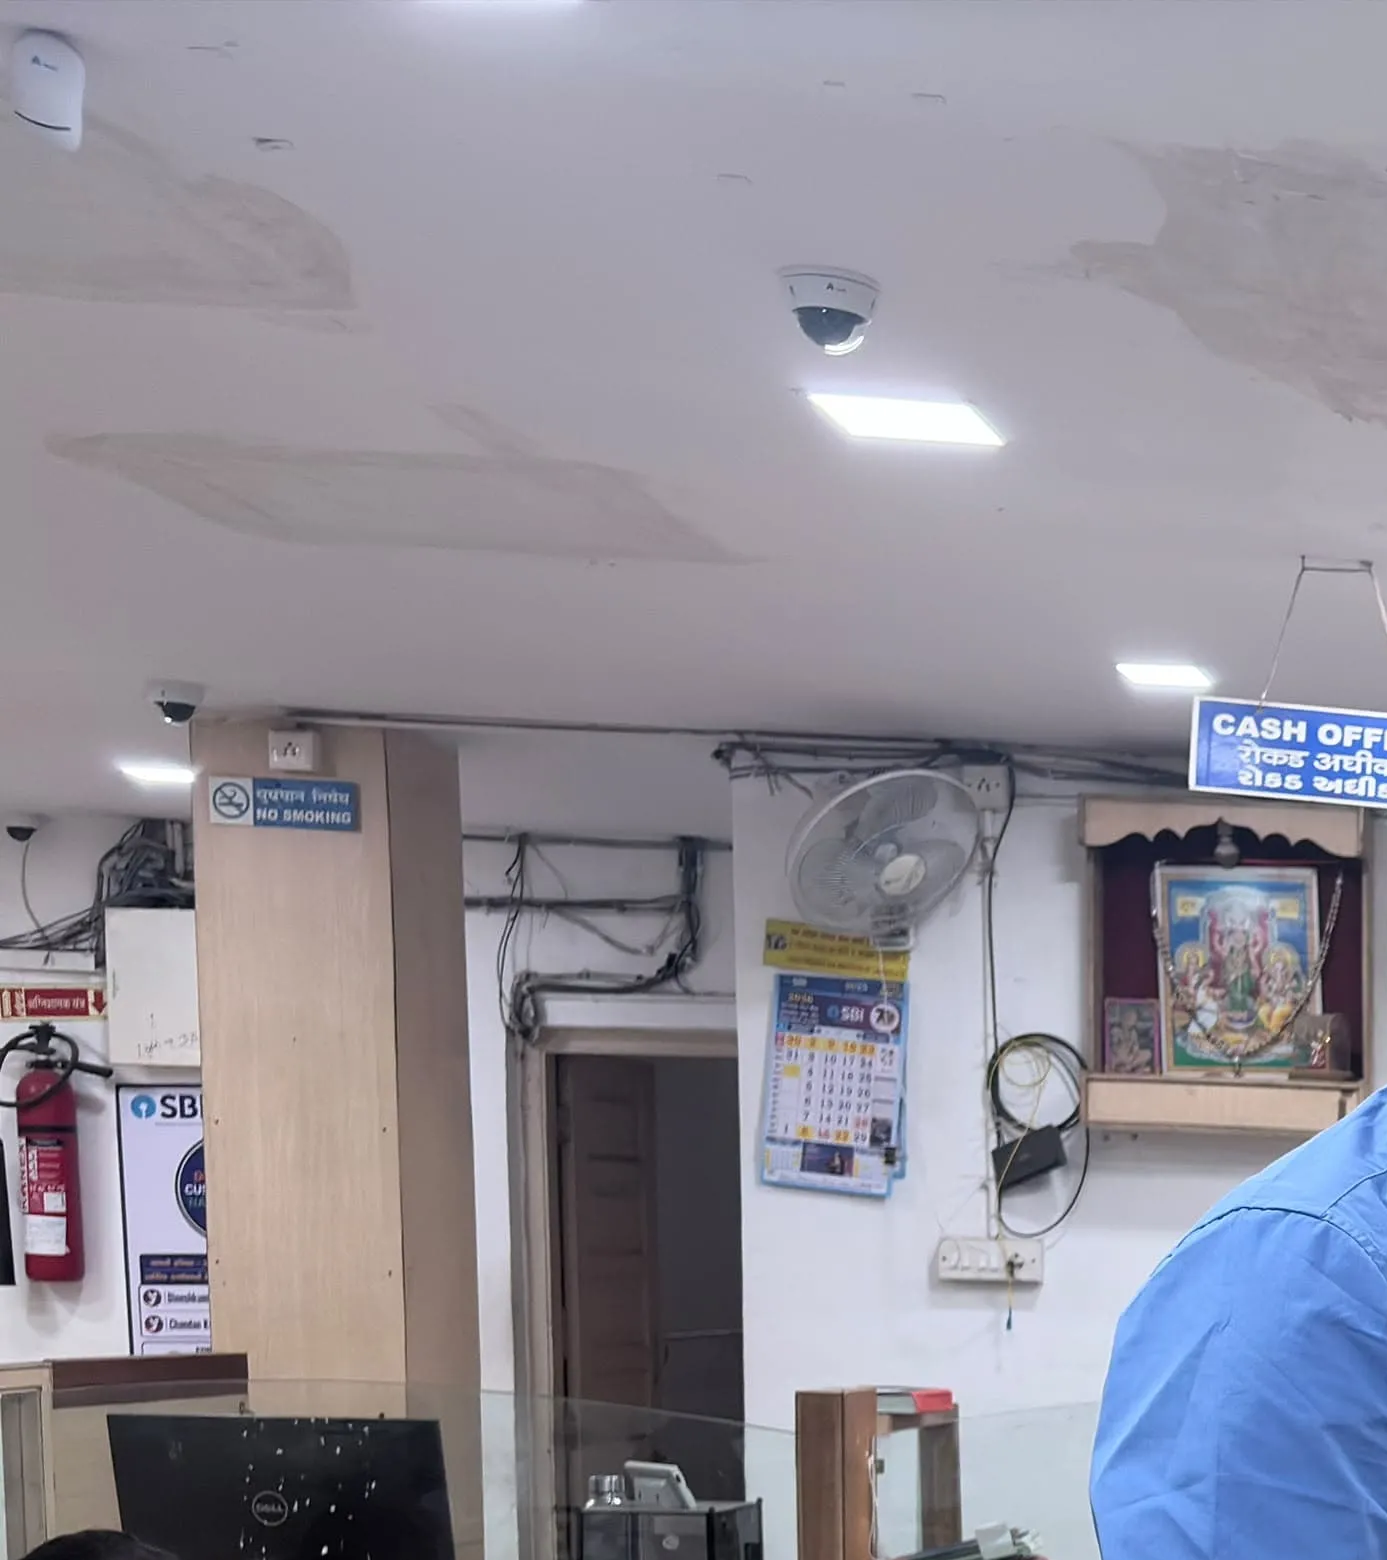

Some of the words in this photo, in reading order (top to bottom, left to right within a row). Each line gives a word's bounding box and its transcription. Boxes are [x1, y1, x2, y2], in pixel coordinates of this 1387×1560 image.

[1213, 714, 1307, 743] CASH
[1238, 740, 1309, 768] रोकड
[1238, 766, 1303, 789] રોકડ
[256, 808, 279, 822] NO
[283, 808, 352, 824] SMOKING
